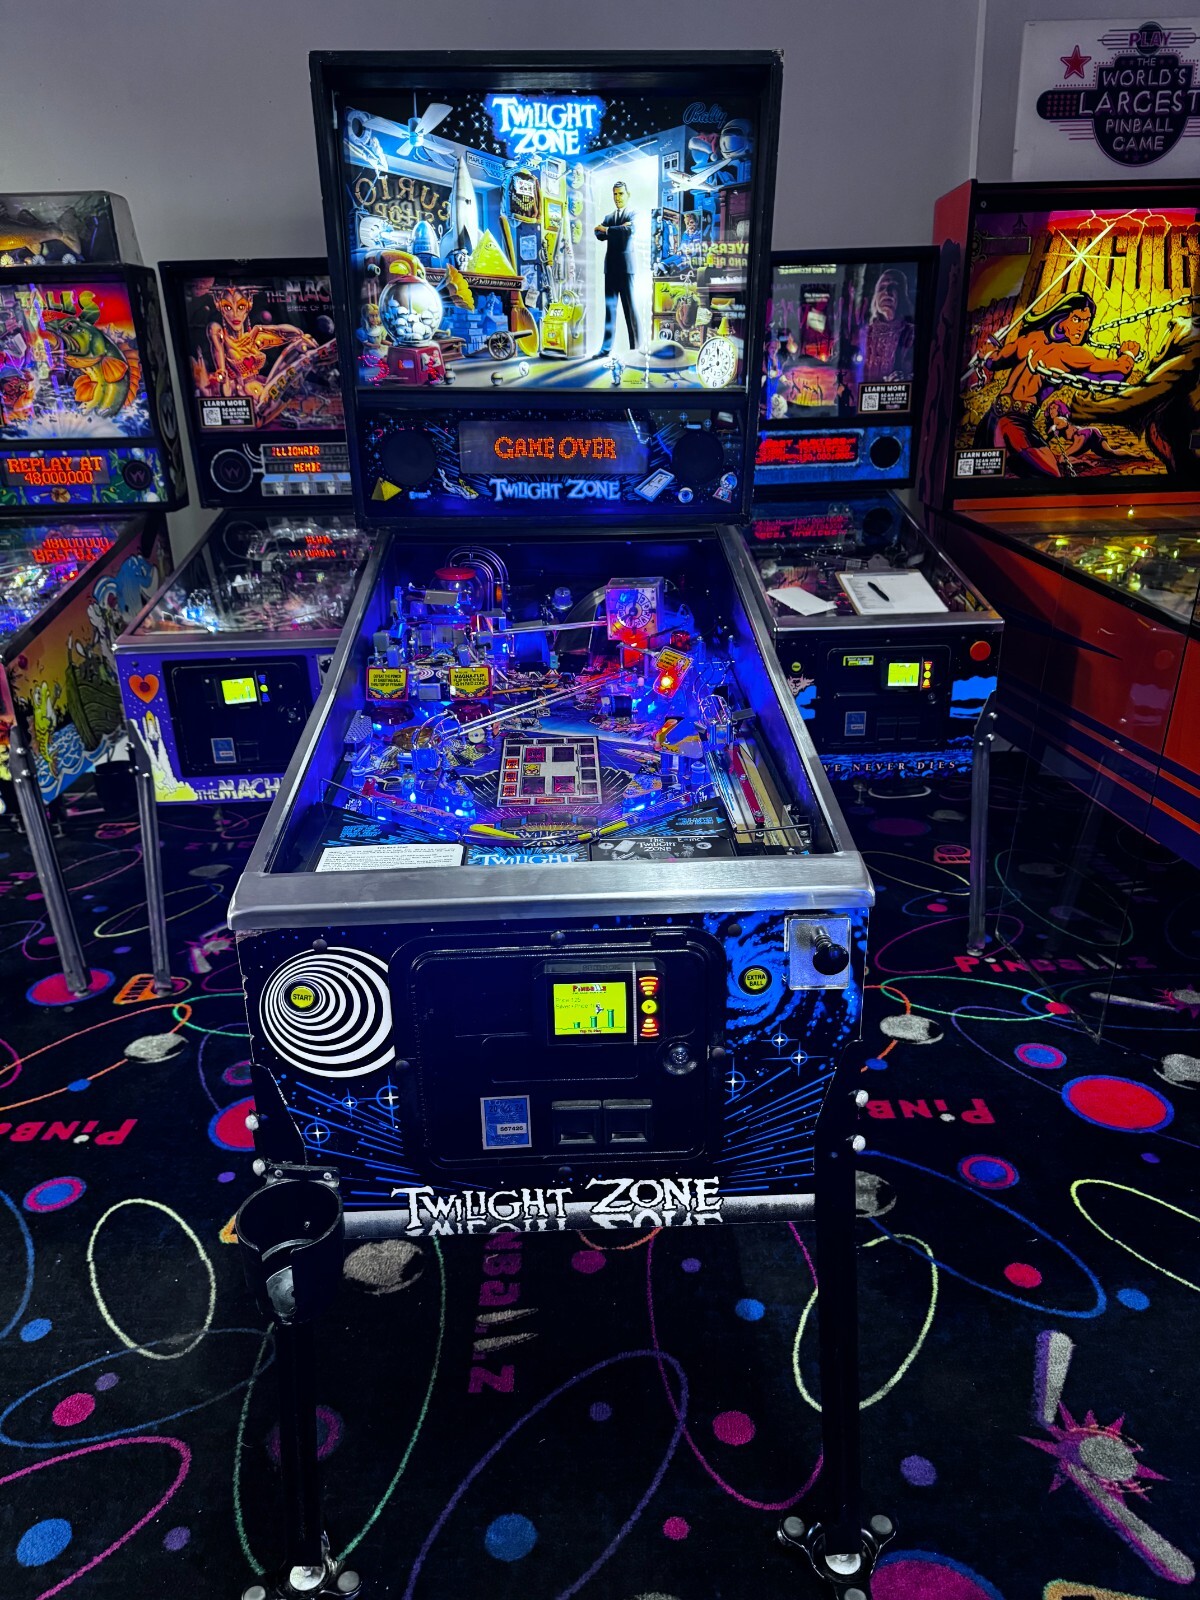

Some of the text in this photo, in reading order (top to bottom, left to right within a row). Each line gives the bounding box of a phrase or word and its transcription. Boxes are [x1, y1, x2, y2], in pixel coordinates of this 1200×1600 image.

[1128, 32, 1172, 47] PLAY
[1137, 57, 1156, 66] THE
[1102, 69, 1186, 86] WORLD'S
[1079, 90, 1200, 115] LARGEST
[492, 97, 598, 132] TWILIGHT
[683, 102, 727, 129] Bally
[1106, 119, 1173, 133] PINBALL
[510, 127, 580, 155] ZONE
[1113, 136, 1164, 150] GAME
[494, 436, 616, 459] GAME OVER
[7, 456, 103, 473] REPLAY AT
[24, 470, 94, 486] 48,000,000
[489, 478, 621, 501] TWILIGHT ZONE
[852, 762, 906, 771] NEVER
[917, 761, 955, 770] DIES
[196, 777, 283, 801] THE MACH
[473, 854, 579, 866] TWILIGHT
[292, 993, 312, 1001] START
[391, 1177, 723, 1229] TWILIGHT ZONE
